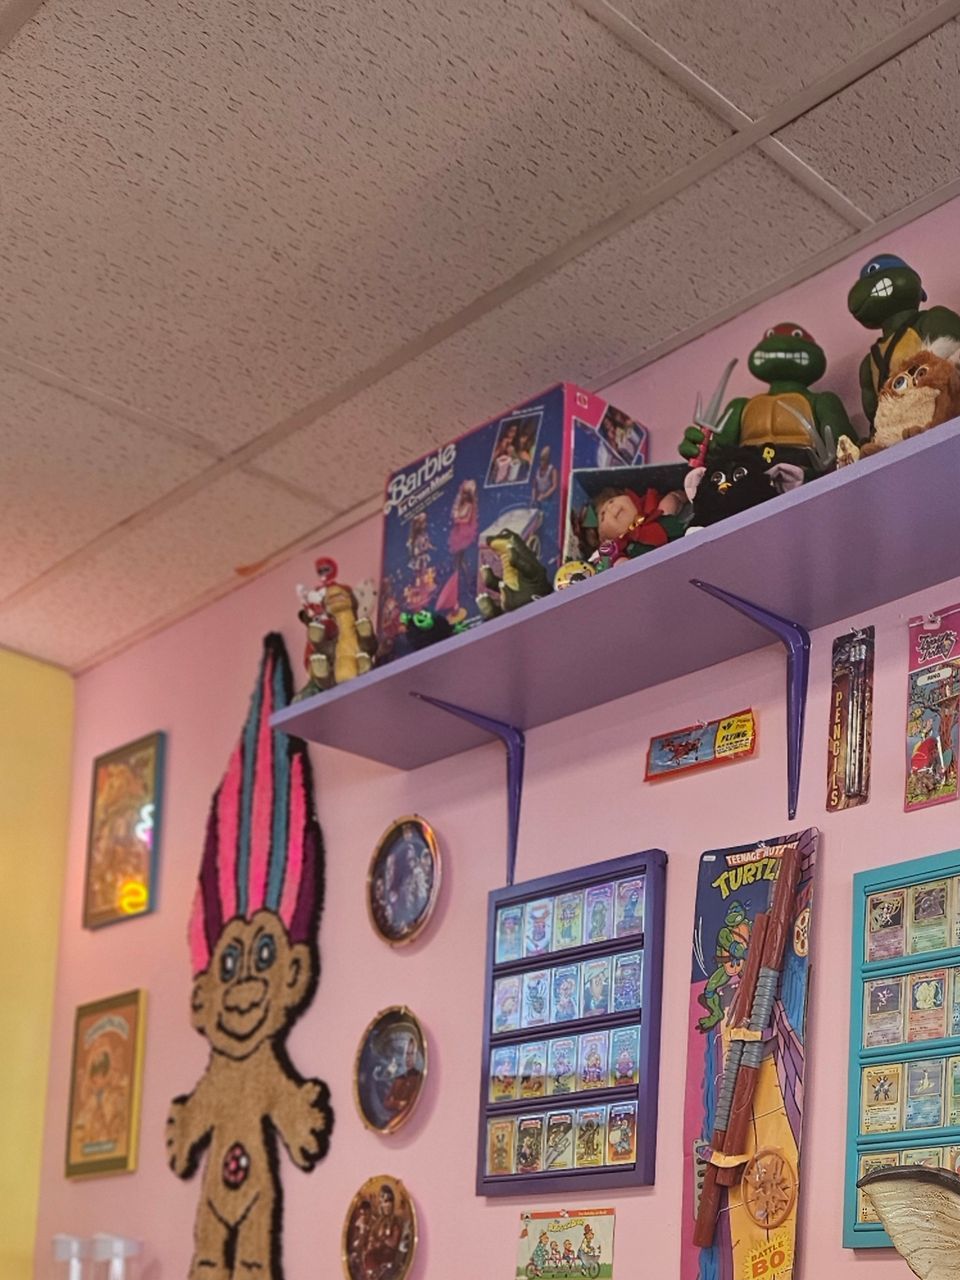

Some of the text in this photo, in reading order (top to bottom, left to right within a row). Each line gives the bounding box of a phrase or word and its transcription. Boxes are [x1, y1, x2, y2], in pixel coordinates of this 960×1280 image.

[384, 444, 456, 514] Barbie
[831, 691, 842, 806] PENCILS
[726, 848, 761, 866] TEENAGE
[712, 858, 783, 899] TURTL
[751, 1240, 785, 1261] BATTLE
[752, 1250, 787, 1278] BO
